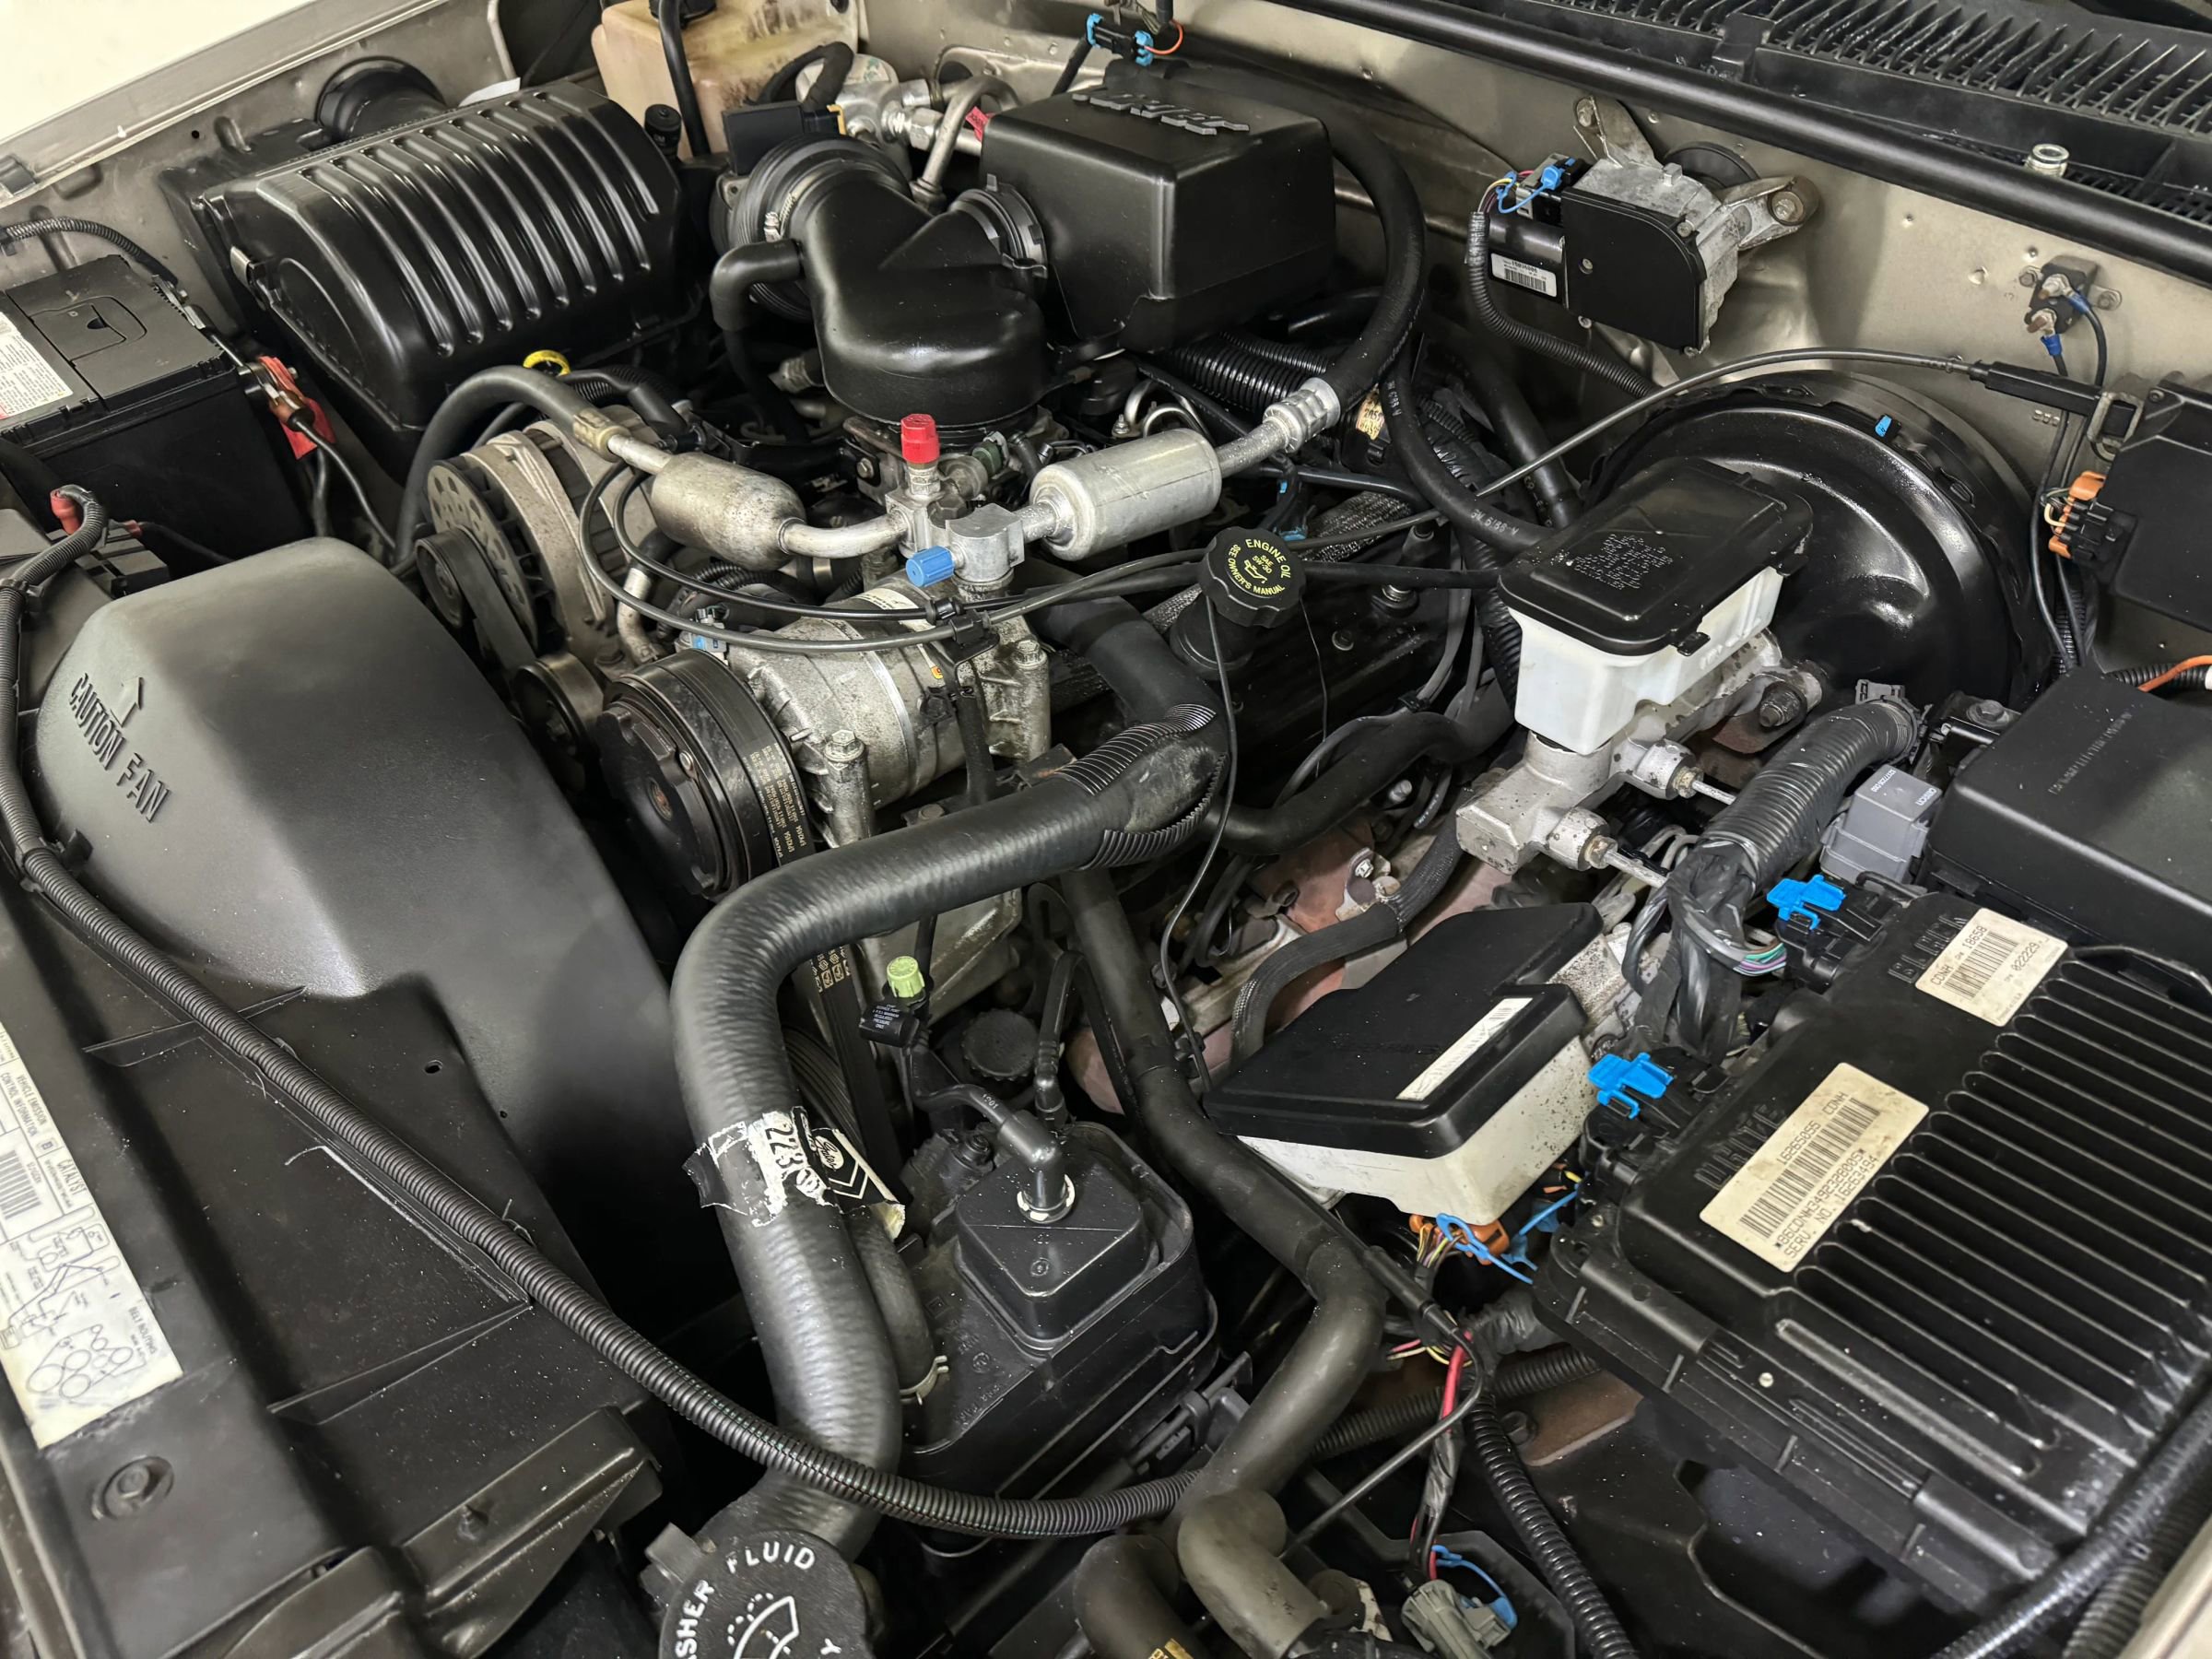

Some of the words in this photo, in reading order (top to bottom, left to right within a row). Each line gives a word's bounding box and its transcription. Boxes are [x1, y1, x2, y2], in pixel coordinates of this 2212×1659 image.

[1229, 544, 1241, 558] SEE
[1245, 539, 1287, 563] ENGINE
[1280, 564, 1291, 579] OIL
[1252, 555, 1273, 573] 5W-30
[1260, 555, 1274, 567] SAE
[1228, 558, 1253, 589] OWNER'S
[1253, 584, 1285, 595] MANUAL
[69, 673, 127, 771] CAUTION
[116, 752, 172, 823] FAN
[1887, 906, 1968, 985] BLACK
[1960, 924, 1987, 949] 18658
[29, 1093, 47, 1126] EMISSION
[1775, 1120, 1821, 1165] 16265055
[1822, 1089, 1849, 1115] CDNH
[56, 1159, 87, 1195] CATALYST
[1783, 1225, 1818, 1258] SERV.
[1814, 1203, 1837, 1223] NO.
[1833, 1153, 1880, 1201] 16263494
[676, 1580, 714, 1659] SHER
[725, 1540, 816, 1575] FLUID
